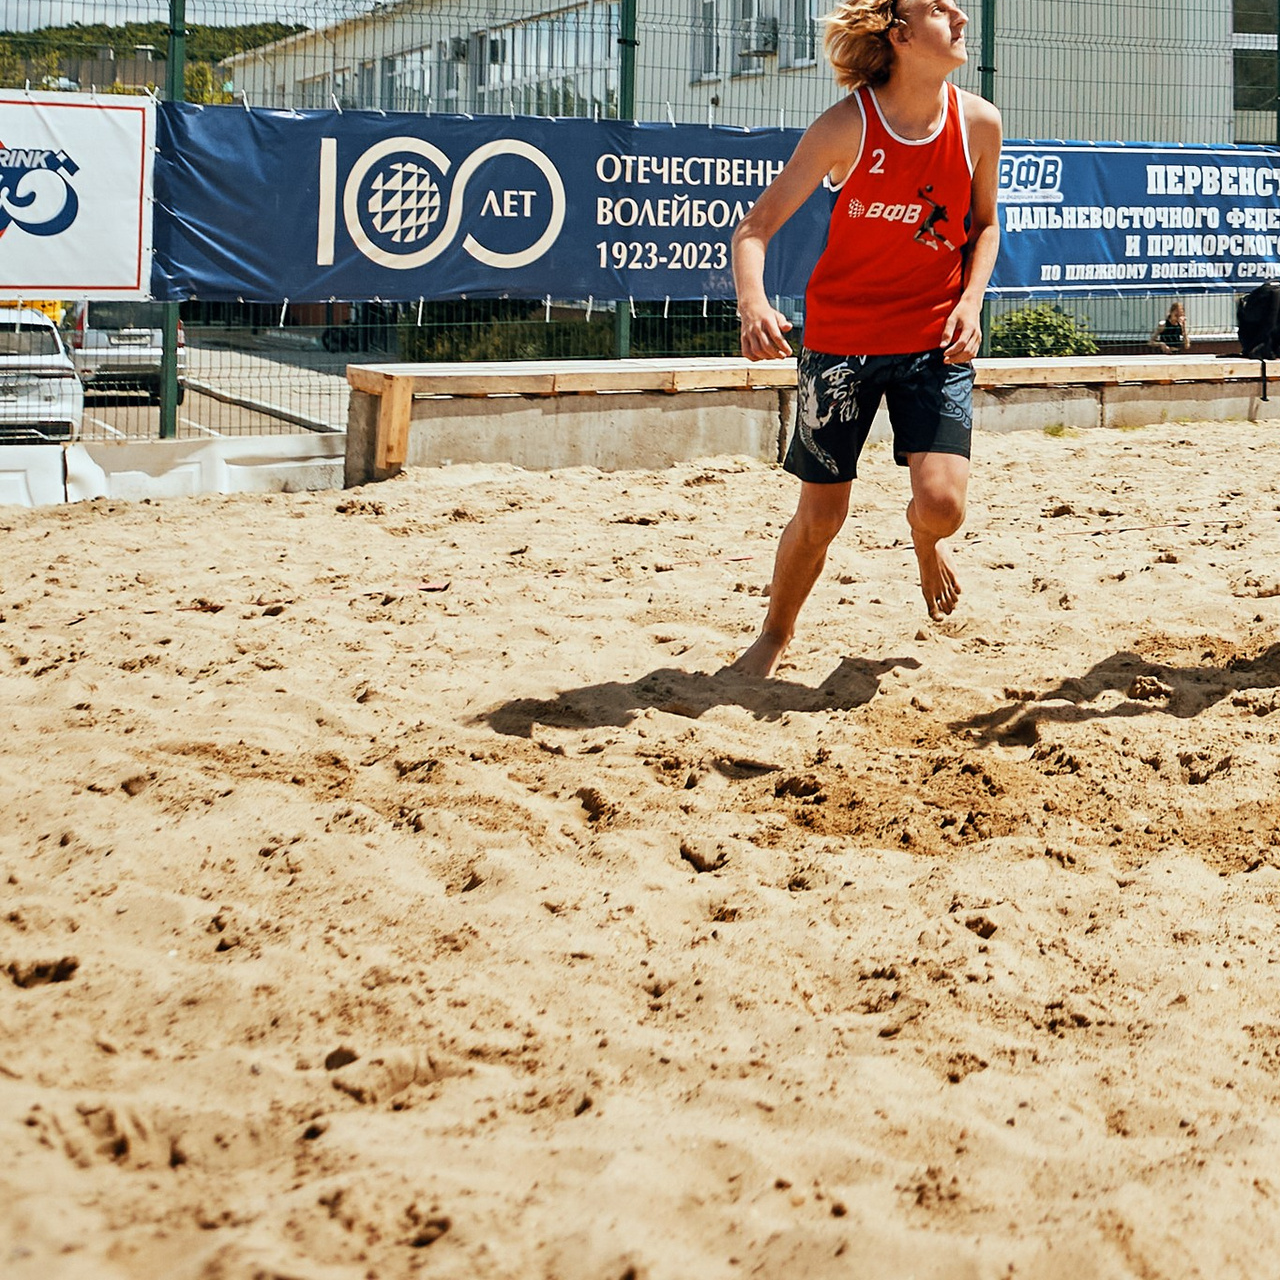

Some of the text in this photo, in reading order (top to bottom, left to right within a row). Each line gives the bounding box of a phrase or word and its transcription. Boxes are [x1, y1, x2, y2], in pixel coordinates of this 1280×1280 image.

[869, 148, 886, 174] 2
[998, 157, 1060, 189] ВФВ
[480, 189, 537, 217] ЛЕТ
[864, 201, 922, 224] ВФВ
[1005, 206, 1220, 232] ДАЛЬНЕВОСТОЧНОГО
[596, 240, 728, 270] 1923-2023
[1125, 235, 1141, 257] И
[1040, 264, 1061, 281] ПО
[1065, 263, 1148, 281] ПЛЯЖНОМУ
[1151, 260, 1234, 280] ВОЛЕЙБОЛУ
